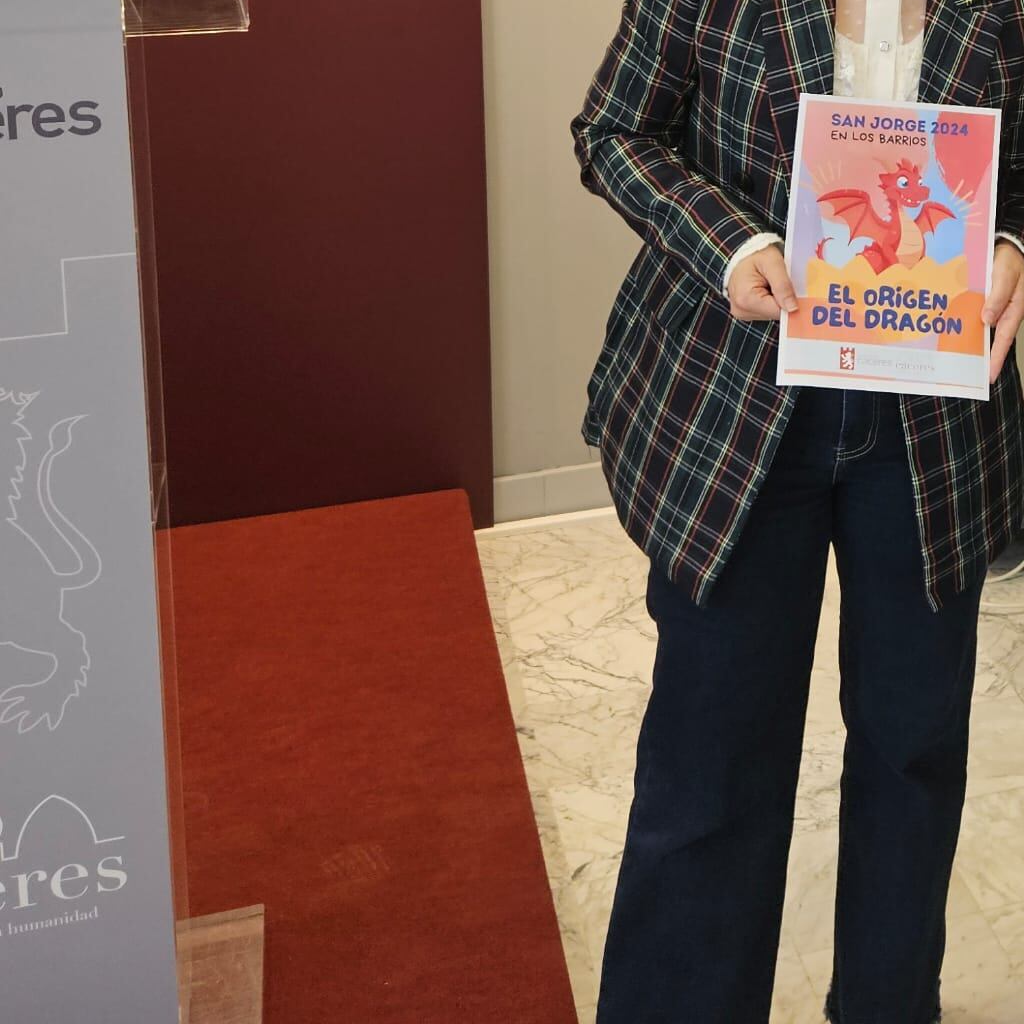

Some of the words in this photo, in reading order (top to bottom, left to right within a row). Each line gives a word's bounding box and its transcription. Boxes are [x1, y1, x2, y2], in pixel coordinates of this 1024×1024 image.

[0, 100, 102, 140] res
[831, 113, 865, 127] SAN
[870, 116, 926, 132] JORGE
[930, 121, 969, 136] 2024
[831, 131, 847, 140] EN
[852, 132, 874, 142] LOS
[879, 135, 926, 146] BARRIOS
[828, 283, 855, 305] EL
[812, 306, 856, 328] DEL
[864, 309, 962, 335] DRAGÓN
[0, 854, 128, 910] res
[8, 905, 99, 935] humanidad
